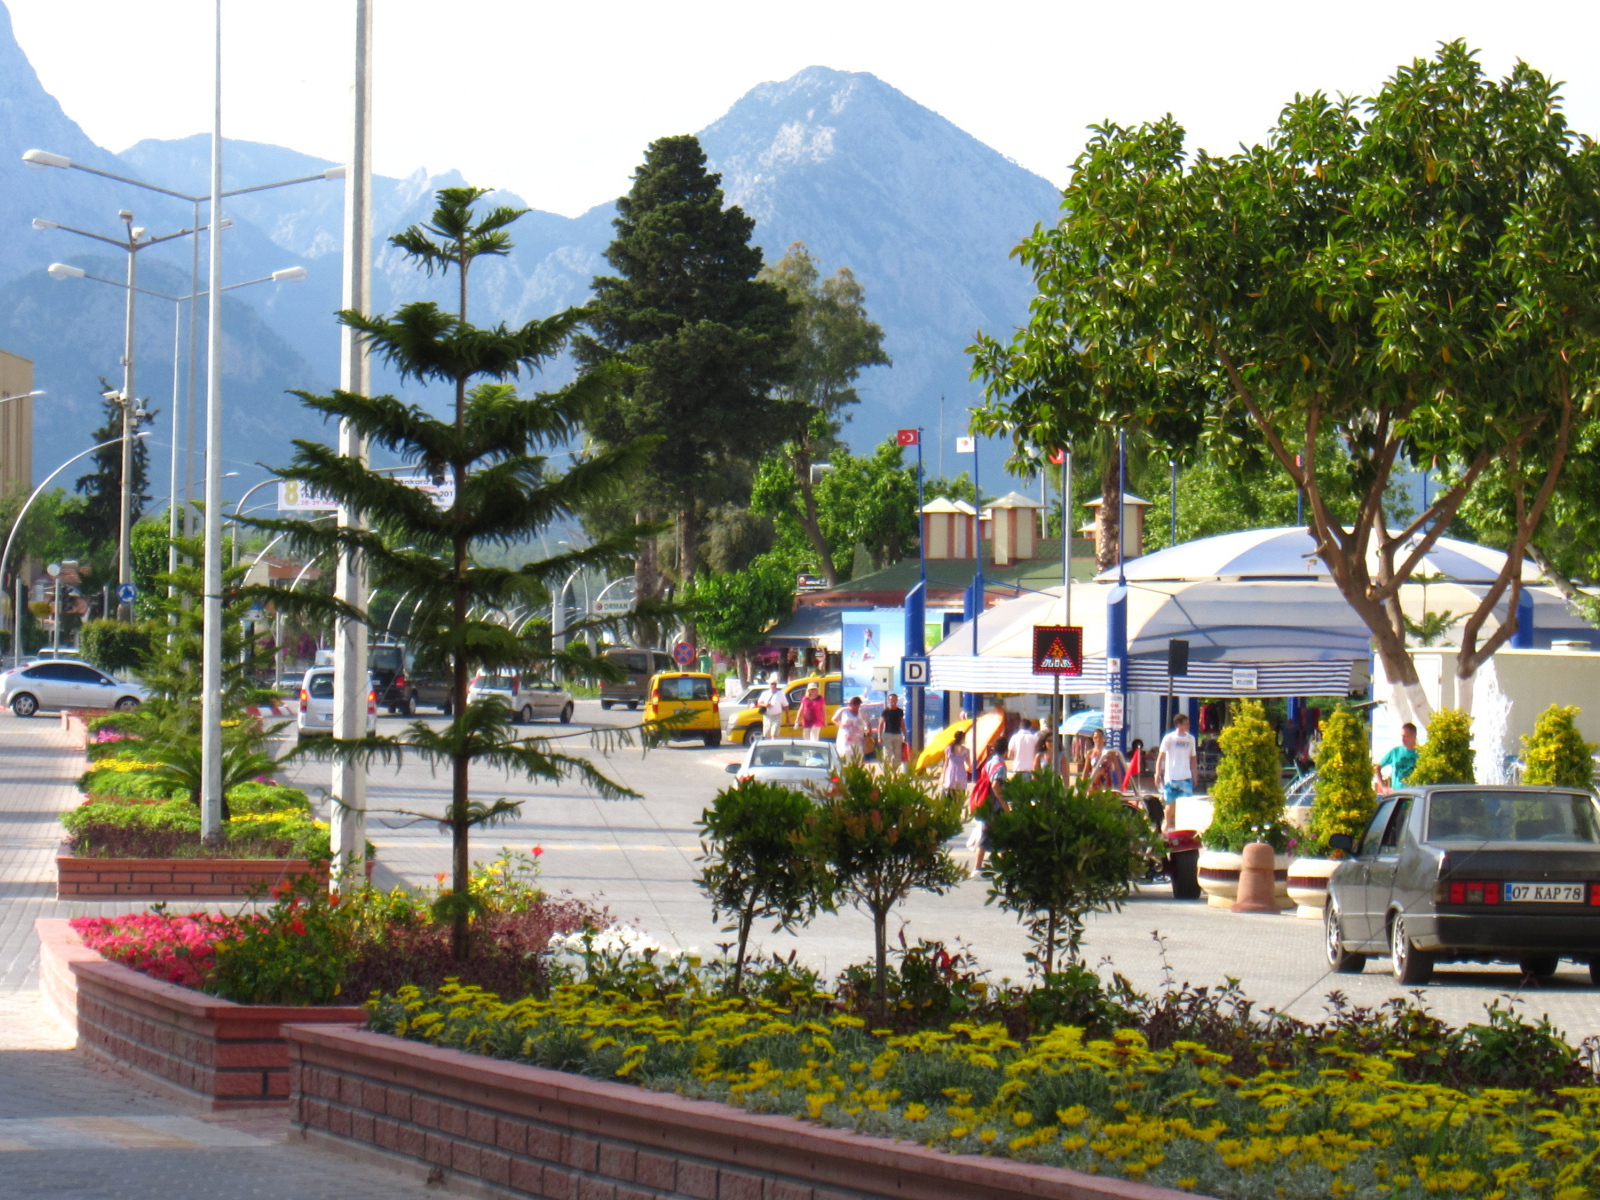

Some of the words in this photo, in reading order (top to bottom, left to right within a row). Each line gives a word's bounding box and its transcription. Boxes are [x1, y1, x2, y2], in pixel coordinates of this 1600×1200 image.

[285, 480, 299, 505] 8
[909, 663, 923, 680] D
[1512, 886, 1530, 899] 07
[1534, 887, 1562, 901] KAP
[1563, 887, 1582, 901] 78
